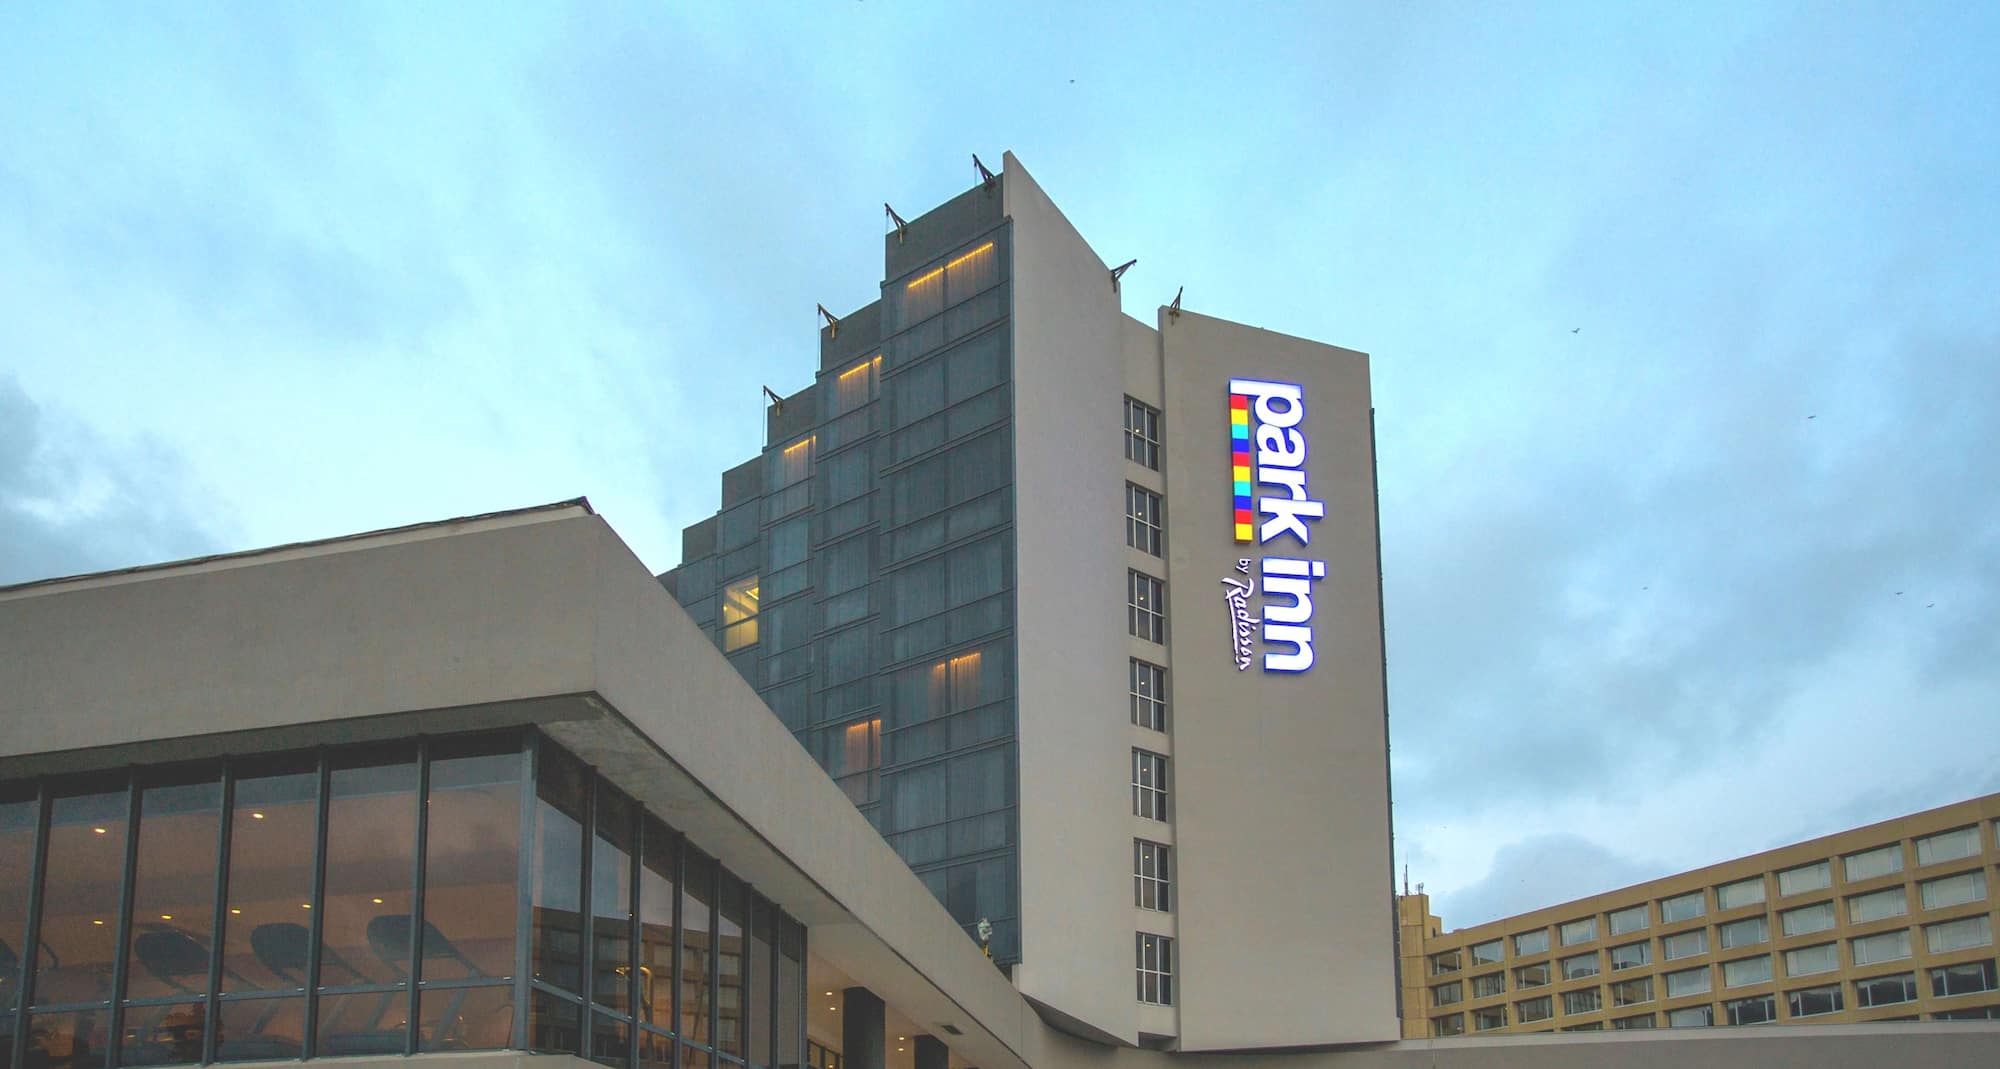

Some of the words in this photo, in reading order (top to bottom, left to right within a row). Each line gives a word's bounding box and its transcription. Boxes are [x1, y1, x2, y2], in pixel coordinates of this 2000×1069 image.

[1229, 379, 1325, 545] park
[1236, 558, 1252, 575] by
[1262, 557, 1327, 672] inn
[1221, 577, 1261, 671] Radisson
